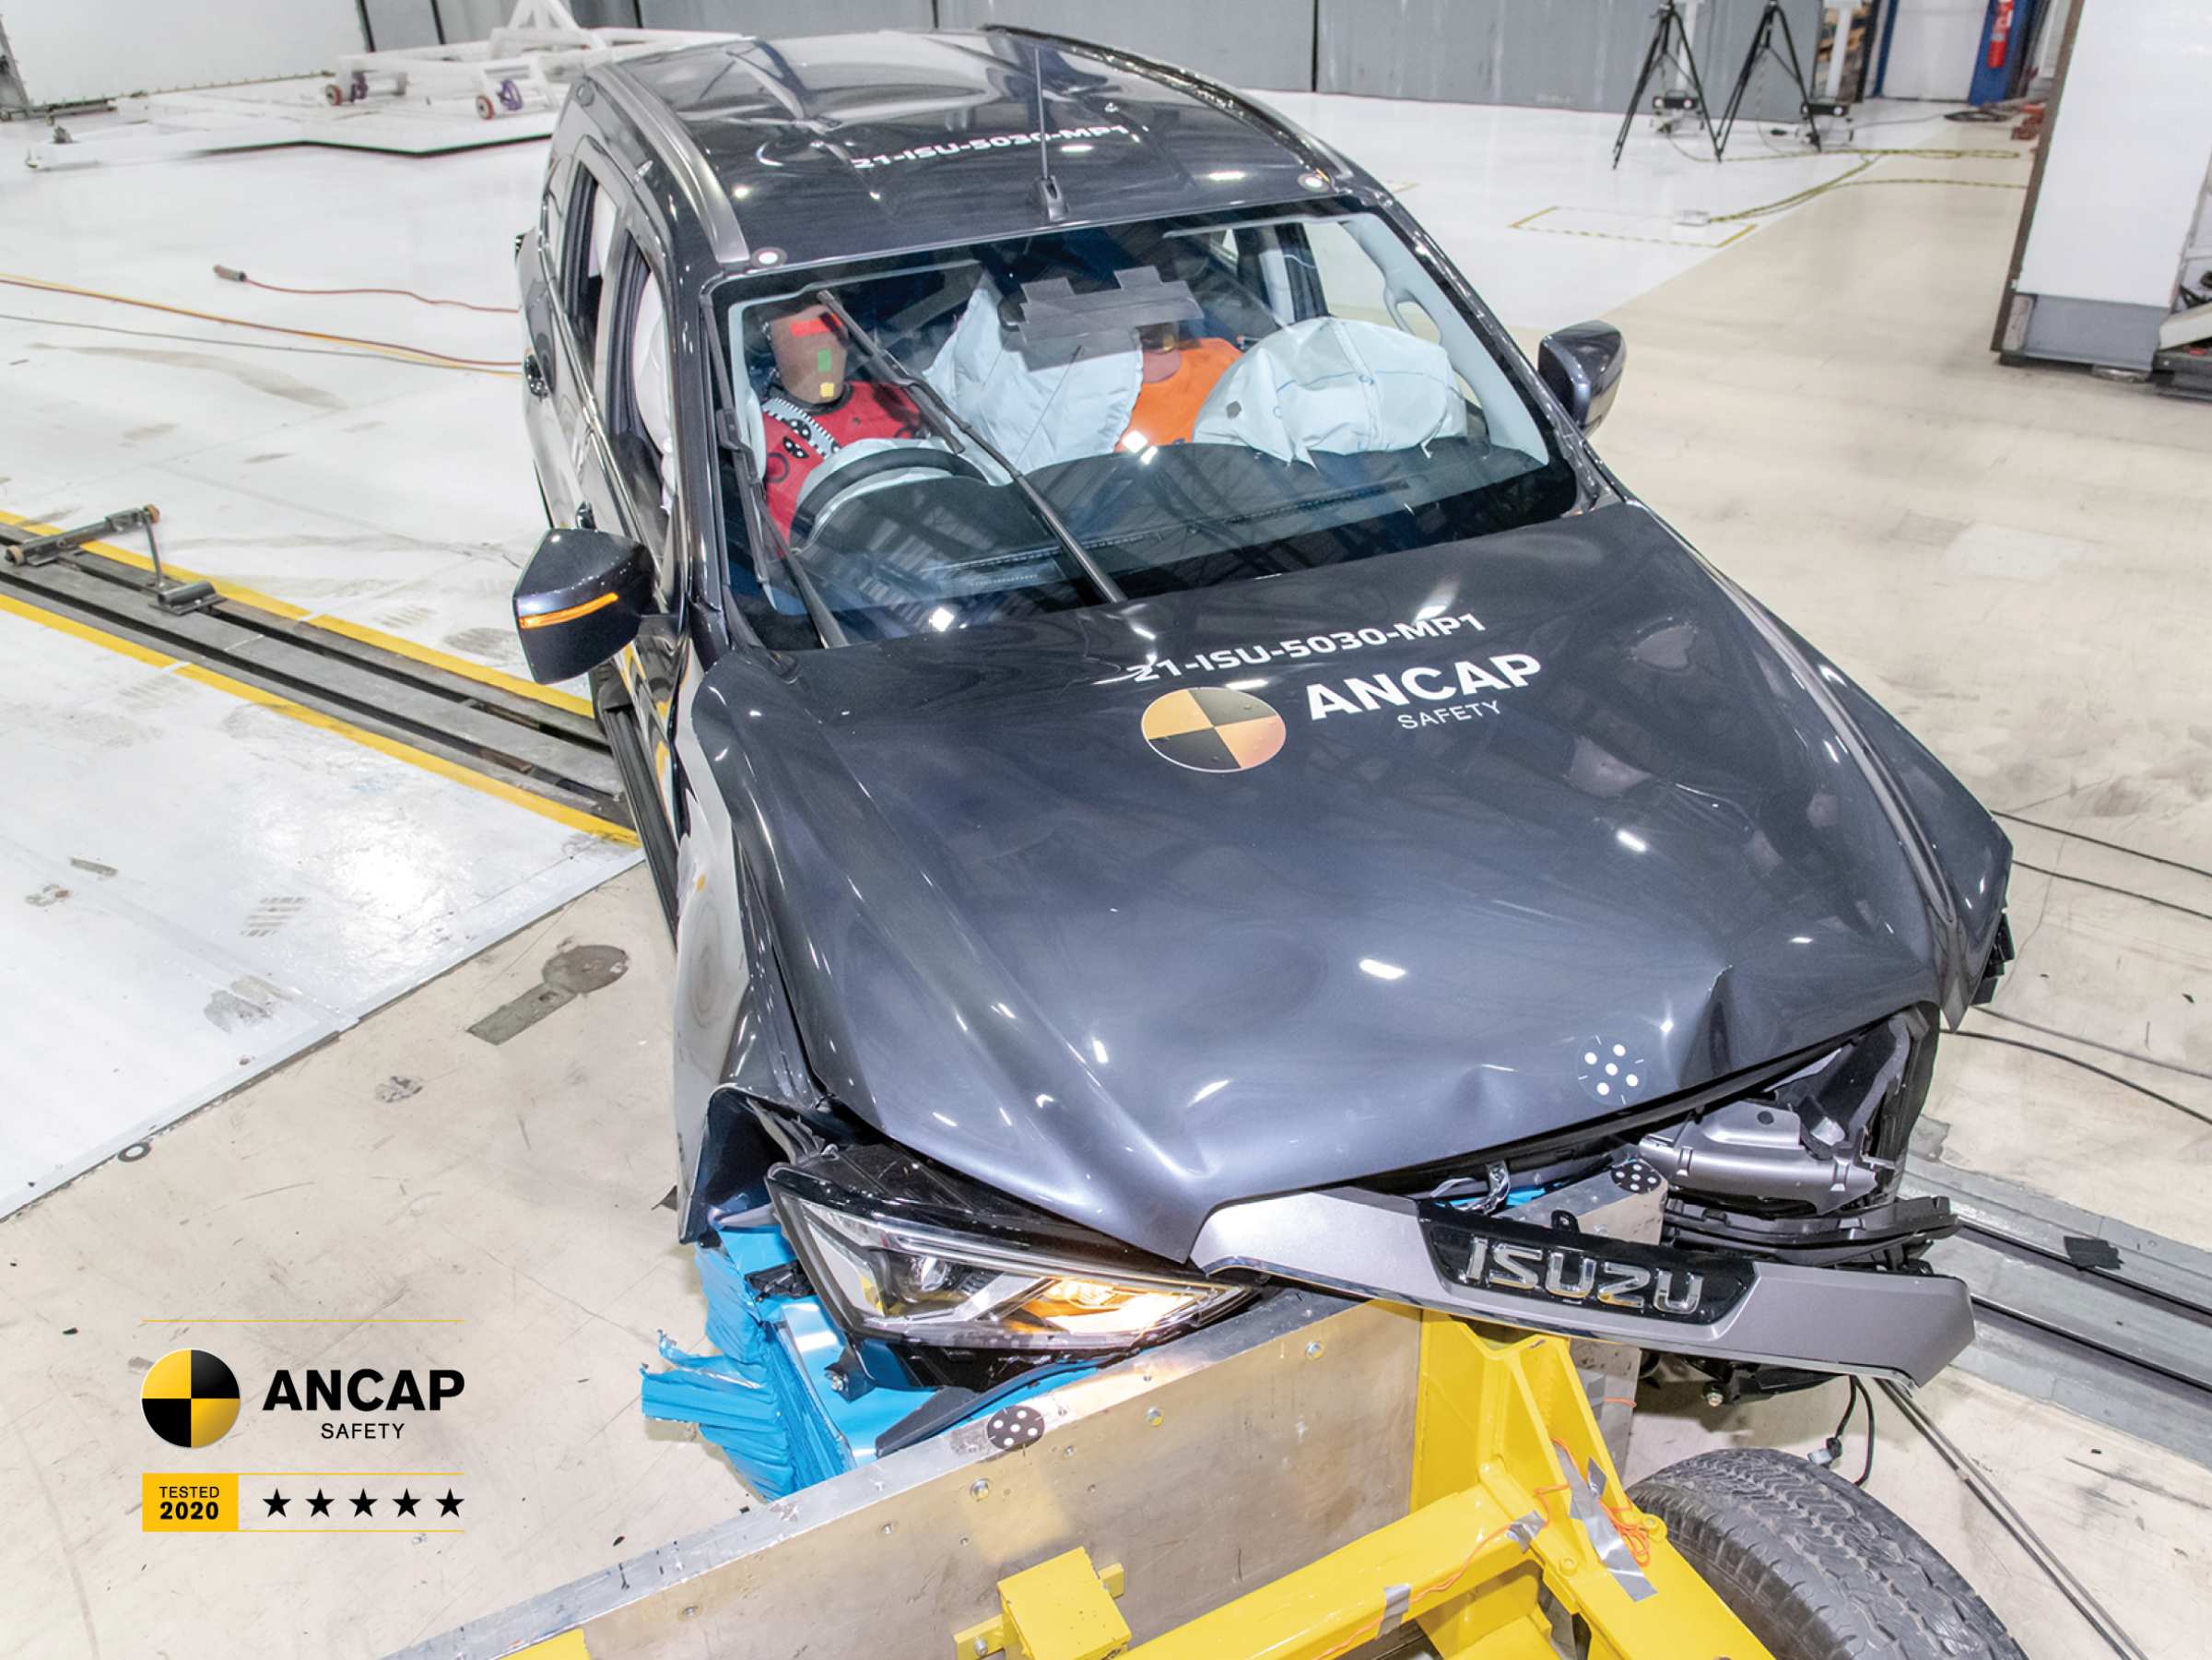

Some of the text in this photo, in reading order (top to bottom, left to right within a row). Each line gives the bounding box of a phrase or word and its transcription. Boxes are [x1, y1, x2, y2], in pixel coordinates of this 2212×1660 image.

[851, 124, 1129, 169] 21-ISU-5030-MP1
[1126, 613, 1487, 683] 21-ISU-5030-MP1
[1305, 653, 1542, 721] ANCAP
[1397, 700, 1503, 730] SAFETY
[1465, 1236, 1704, 1314] ISUZU
